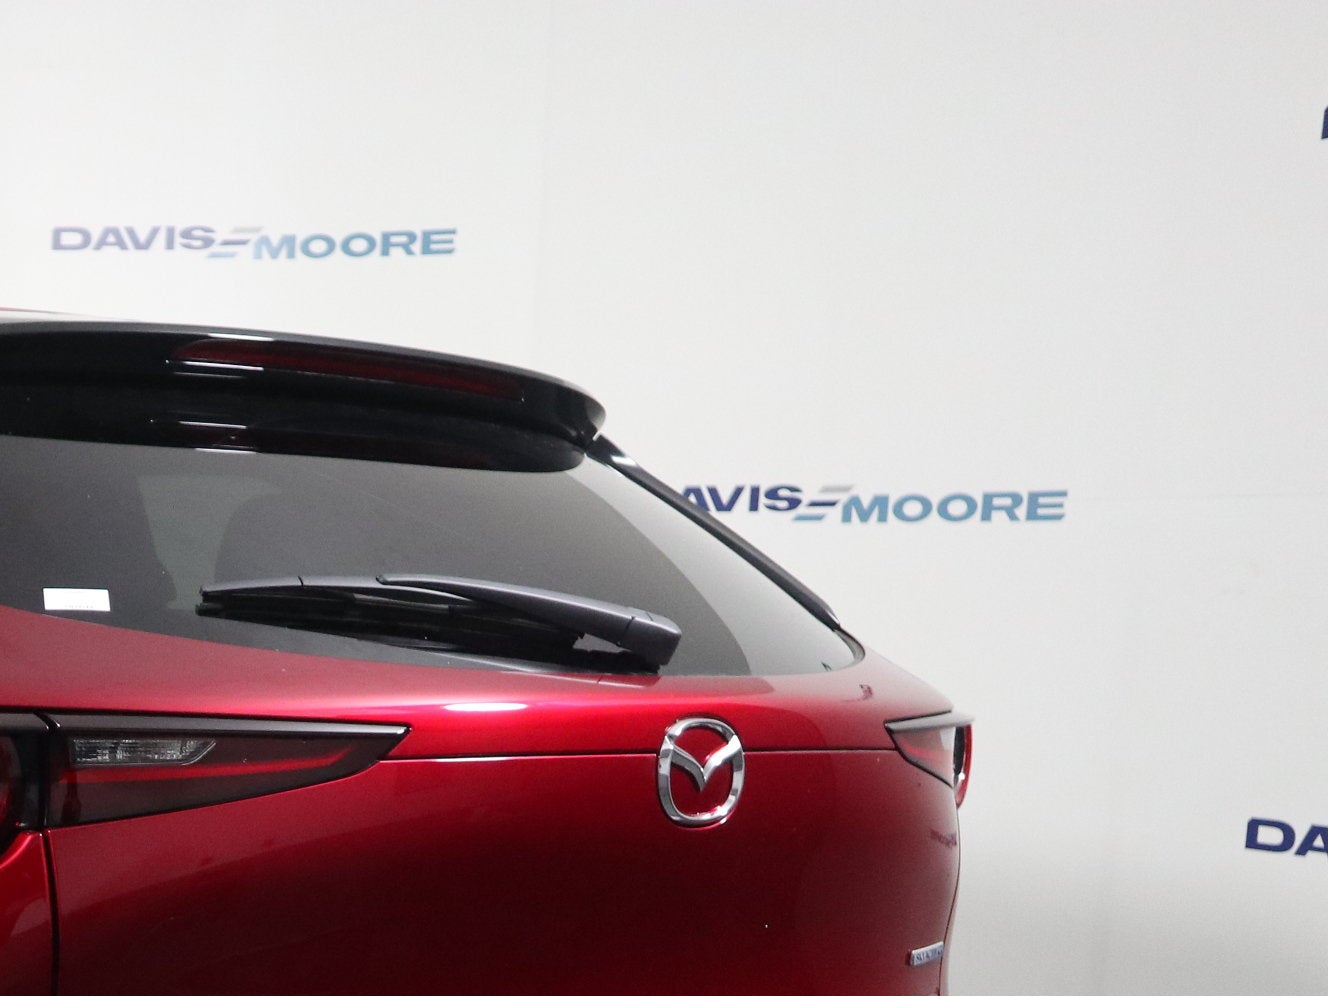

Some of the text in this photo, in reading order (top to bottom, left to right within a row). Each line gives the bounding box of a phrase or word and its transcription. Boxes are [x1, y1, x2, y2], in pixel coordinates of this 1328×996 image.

[51, 225, 458, 260] DAVIS MOORE
[679, 484, 1069, 524] AVIS MOORE
